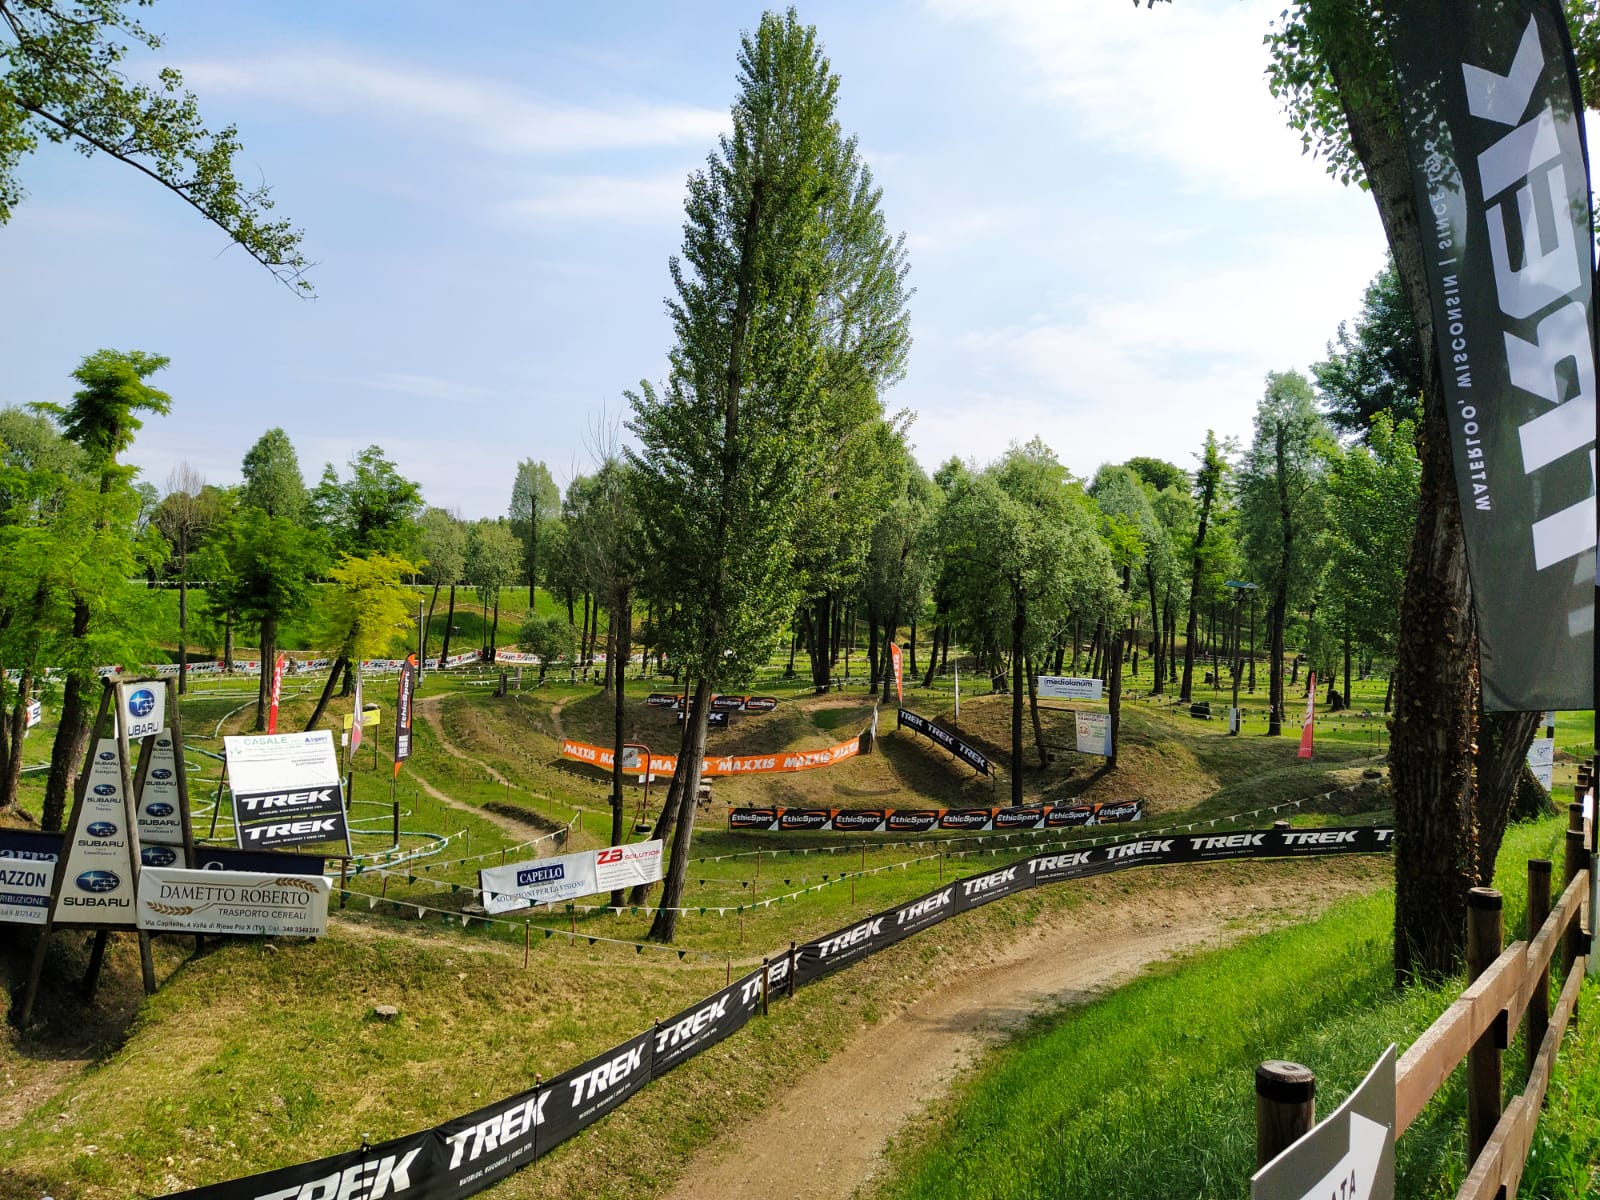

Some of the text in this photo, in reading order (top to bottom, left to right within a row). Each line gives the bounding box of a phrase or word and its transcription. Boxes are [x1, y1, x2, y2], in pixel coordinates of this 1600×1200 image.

[243, 736, 288, 746] CASALE
[900, 710, 985, 767] TREK TREK TREK
[564, 743, 597, 761] MAXXIS
[717, 758, 775, 772] MAXXIS
[242, 789, 334, 811] TREK
[138, 819, 181, 827] SUBARU
[731, 813, 774, 822] EthicSport
[782, 815, 827, 823] EthicSport
[836, 815, 881, 824] EthicSport
[889, 815, 935, 824] EthicSport
[943, 814, 988, 823] EthicSport
[996, 813, 1040, 823] EthicSport
[1049, 810, 1091, 820] EthicSport
[244, 818, 337, 841] TREK
[1281, 830, 1361, 845] TREK
[78, 840, 124, 848] SUBARU
[1105, 839, 1175, 860] TREK
[1189, 833, 1267, 850] TREK
[1027, 850, 1093, 874] TREK
[519, 867, 562, 884] CAPELLO
[962, 865, 1018, 896] TREK
[63, 896, 130, 908] SUBARU
[160, 884, 310, 906] DAMETTO ROBERTO
[896, 887, 953, 925] TREK
[219, 908, 307, 920] TRASPORTO CEREALI
[817, 916, 885, 960] TREK
[741, 951, 804, 1005] TREK
[655, 993, 731, 1053] TREK
[569, 1042, 646, 1108] TREK
[446, 1089, 553, 1171] TREK
